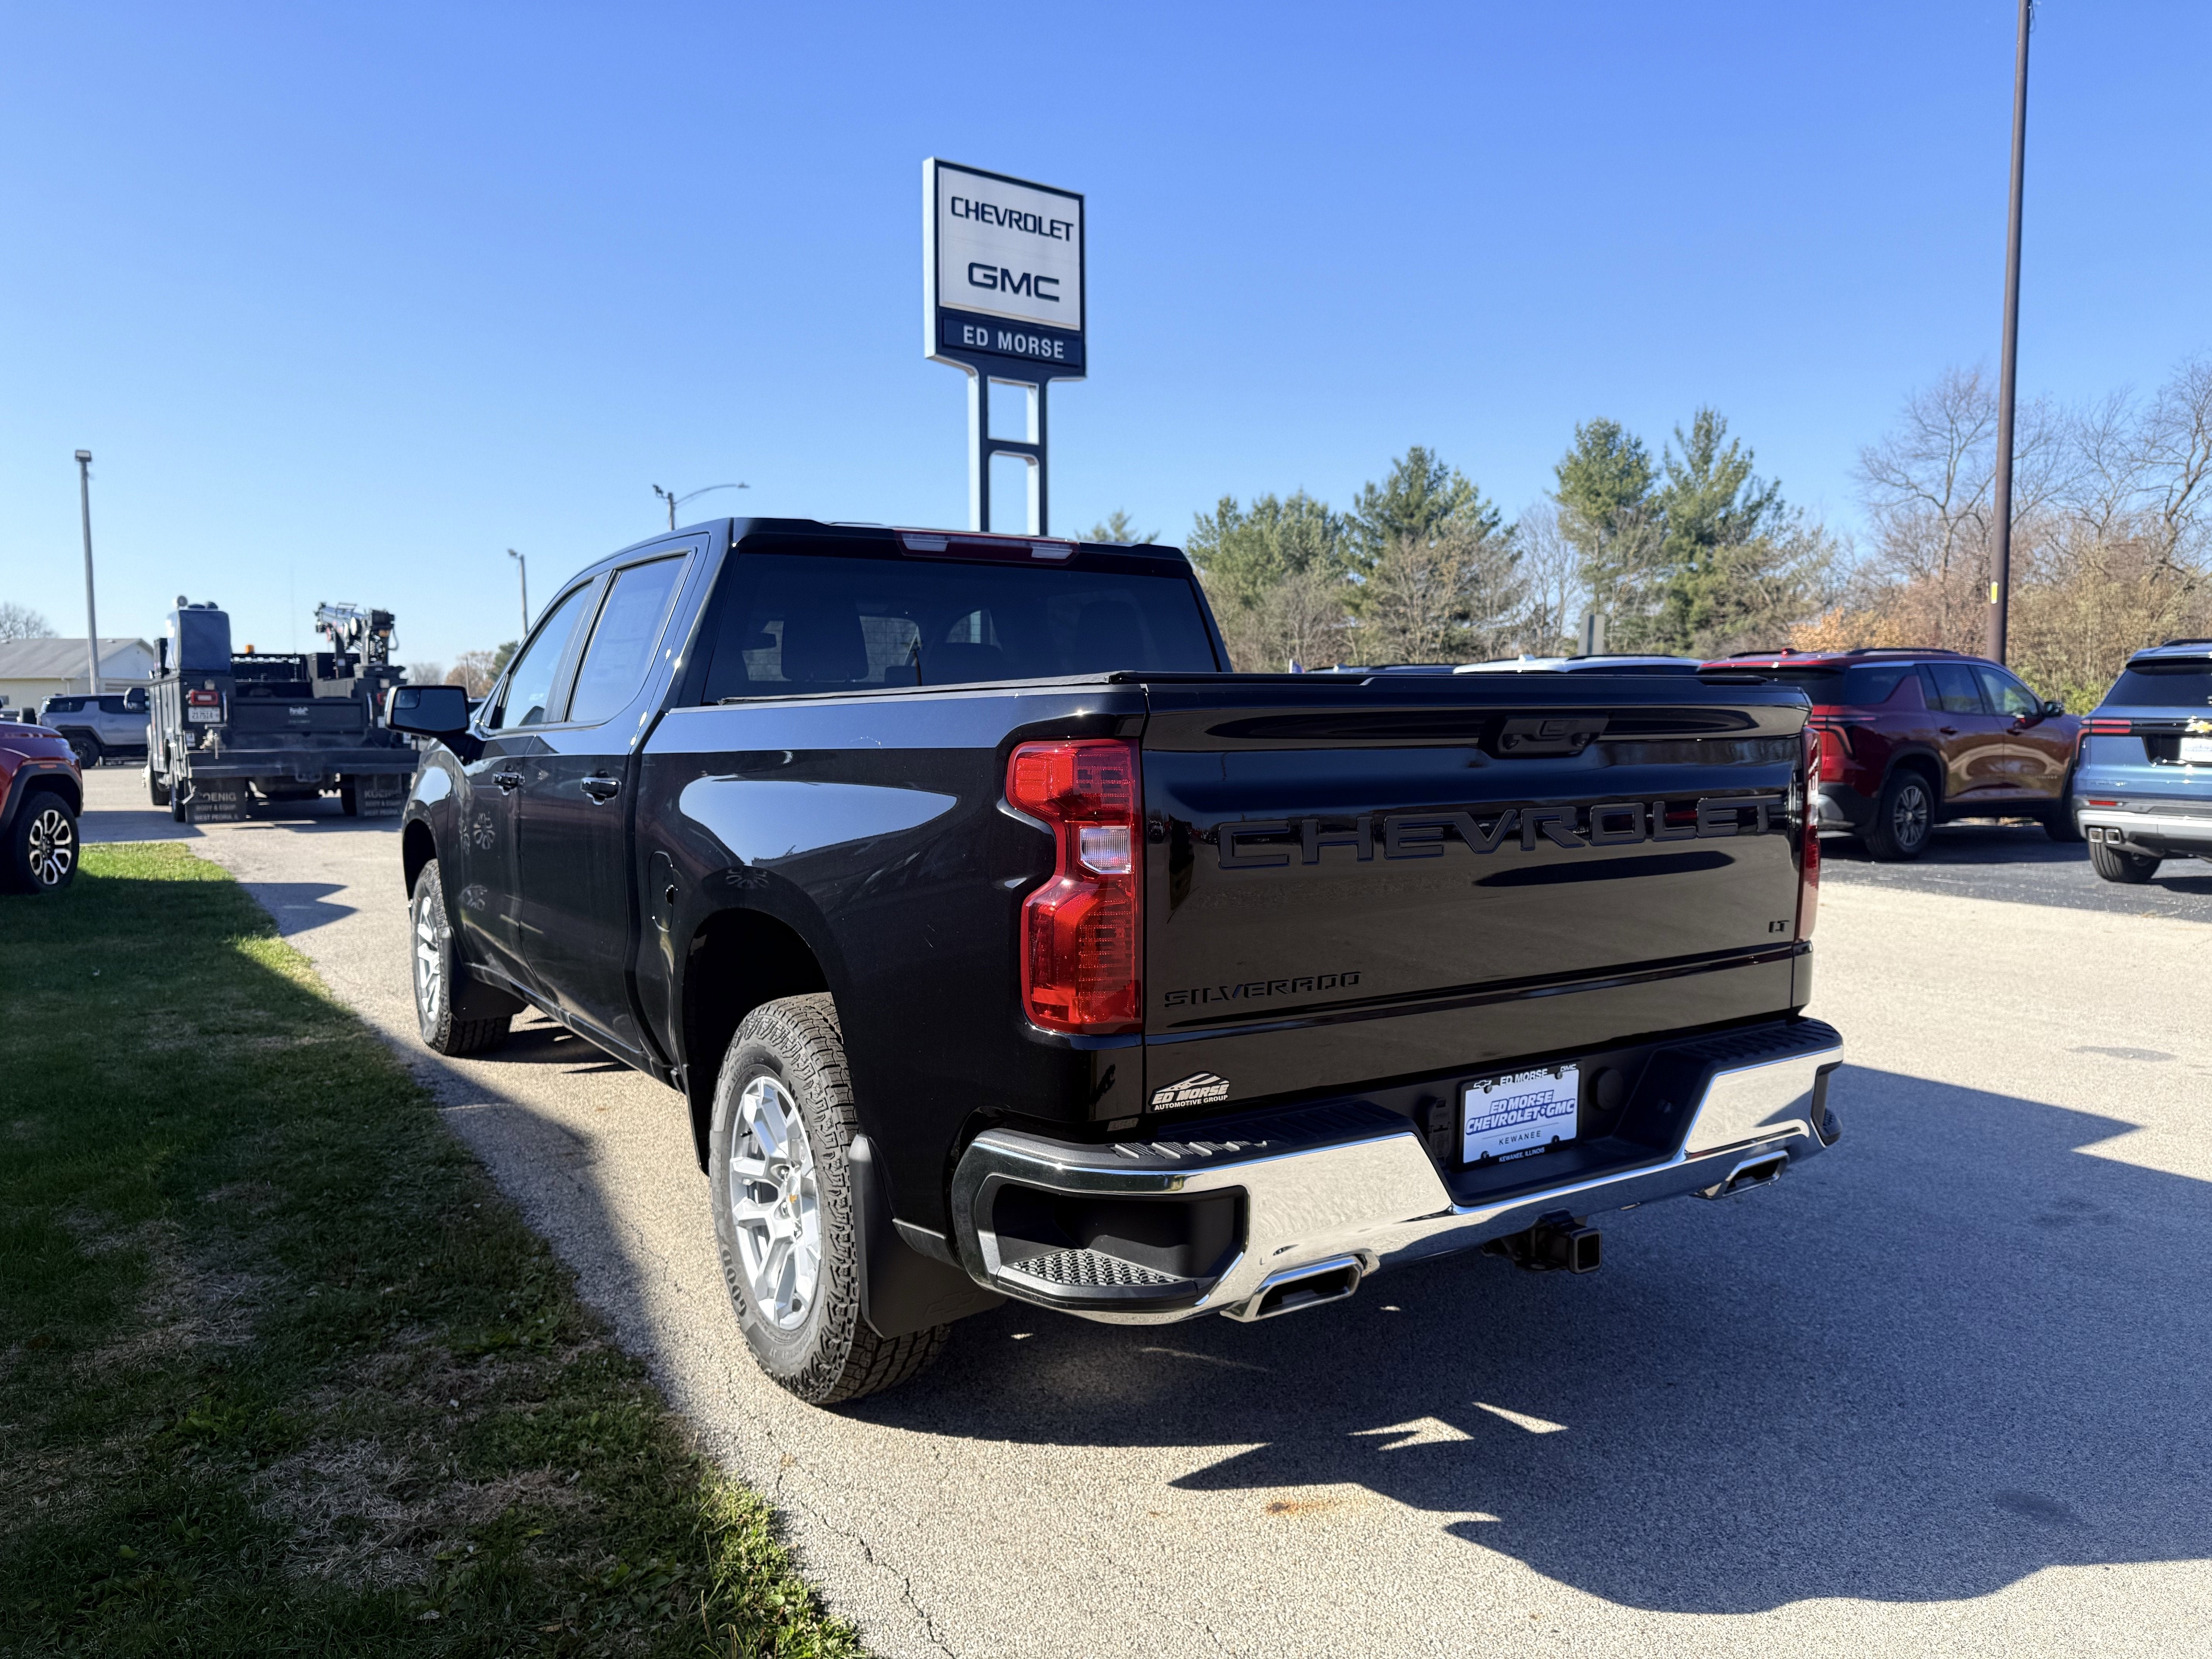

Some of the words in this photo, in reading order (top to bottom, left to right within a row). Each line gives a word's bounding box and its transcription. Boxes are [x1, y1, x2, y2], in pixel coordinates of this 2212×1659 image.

[951, 196, 1074, 242] CHEVROLET
[968, 262, 1060, 302] GMC
[963, 325, 989, 347] ED
[998, 330, 1064, 359] MORSE
[1218, 795, 1786, 870] CHEVROLET
[1769, 920, 1790, 933] LT
[1164, 971, 1361, 1007] SILVERADO
[1500, 1075, 1512, 1085] ED
[1514, 1068, 1548, 1084] MORSE
[1152, 1092, 1174, 1104] ED
[1176, 1084, 1230, 1101] MORSE
[1154, 1098, 1202, 1111] AUTOMOTIVE
[1203, 1094, 1228, 1103] GROUP
[1490, 1098, 1508, 1115] ED
[1508, 1089, 1554, 1111] MORSE
[1466, 1106, 1540, 1135] CHEVROLET
[1546, 1098, 1576, 1119] GMC
[1499, 1130, 1541, 1146] KEWANEE
